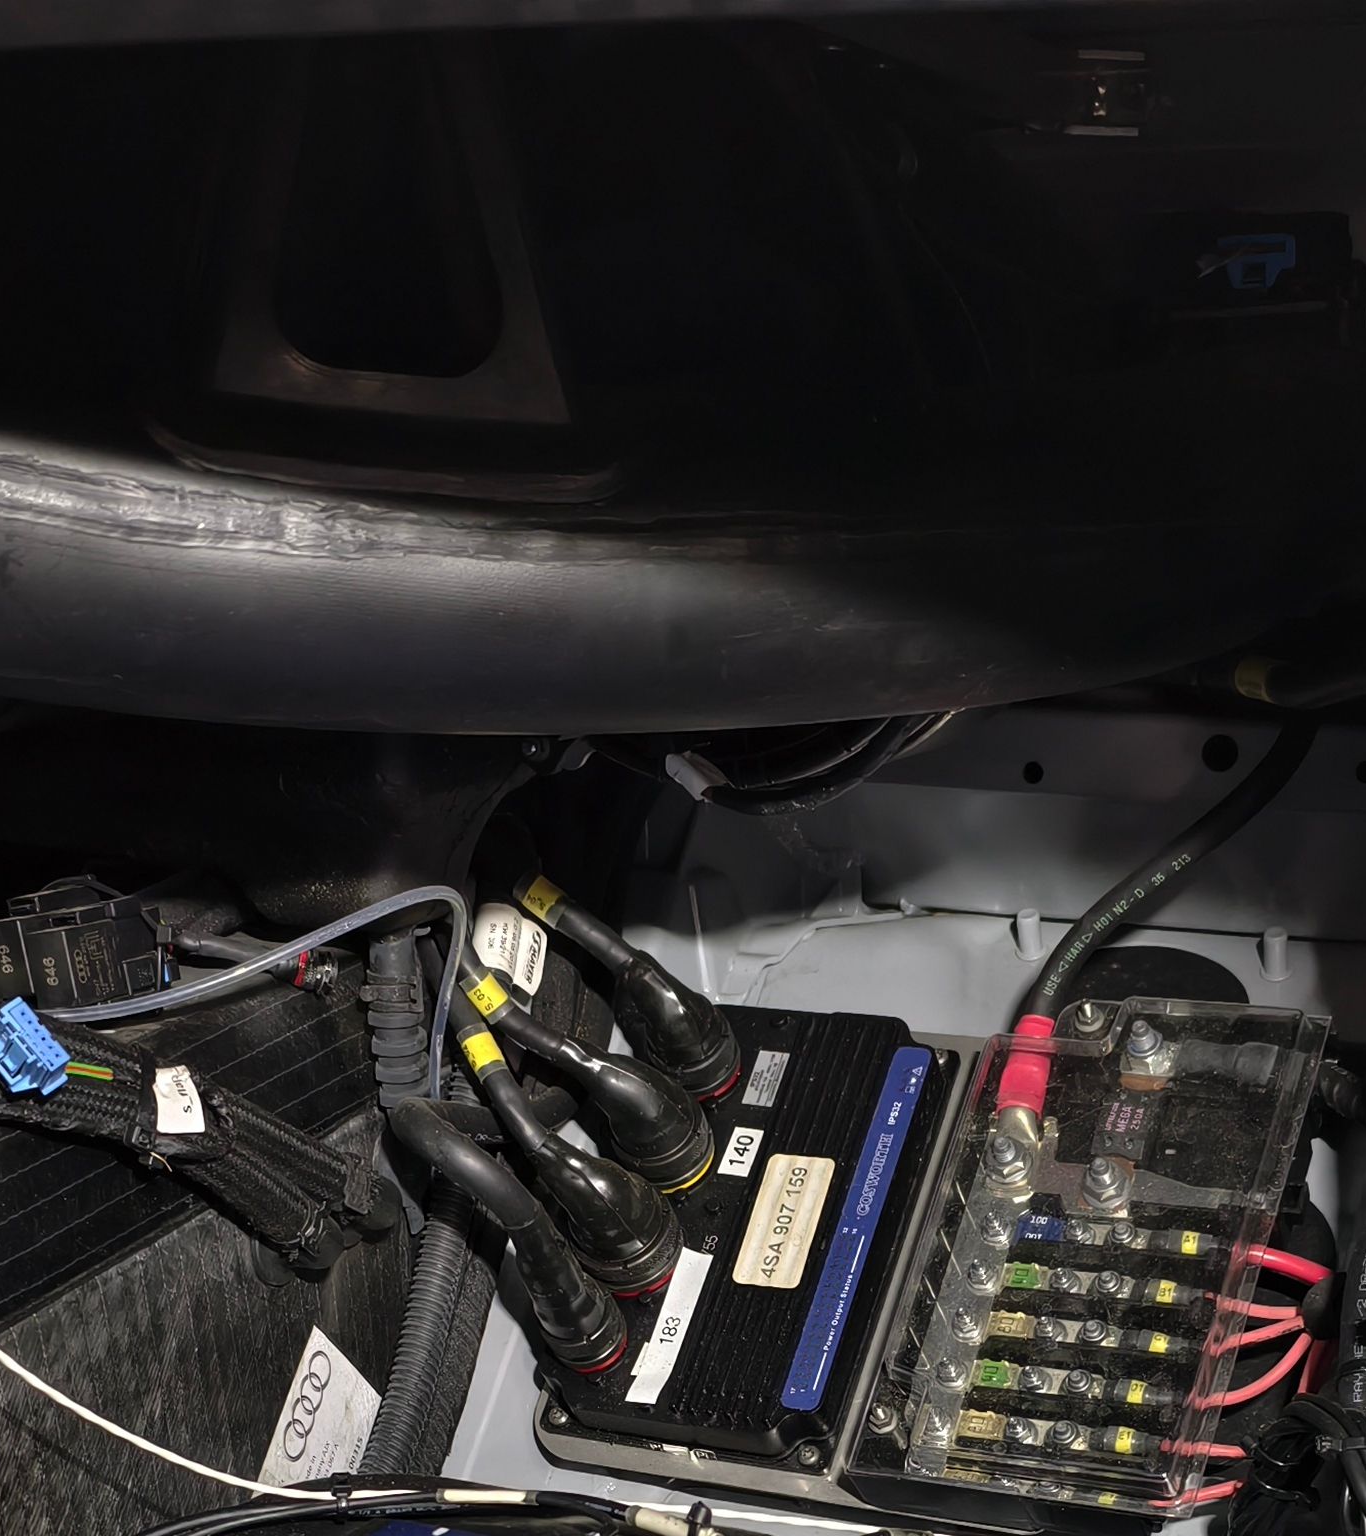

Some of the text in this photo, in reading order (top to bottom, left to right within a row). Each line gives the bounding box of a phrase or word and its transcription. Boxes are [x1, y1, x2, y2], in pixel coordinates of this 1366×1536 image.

[1043, 974, 1061, 997] USE
[1064, 941, 1084, 962] HAR
[1151, 872, 1165, 886] 35
[1171, 854, 1191, 870] 213
[42, 956, 59, 986] 646
[888, 1101, 902, 1126] IPS32
[1115, 1106, 1132, 1132] MEGA
[1130, 1108, 1145, 1130] 250A
[728, 1135, 755, 1166] 140
[856, 1133, 894, 1217] COSWORTH
[761, 1167, 808, 1279] 4SA 907 159
[1030, 1216, 1048, 1225] 100
[824, 1274, 853, 1351] Power Output Status
[659, 1316, 681, 1345] 183
